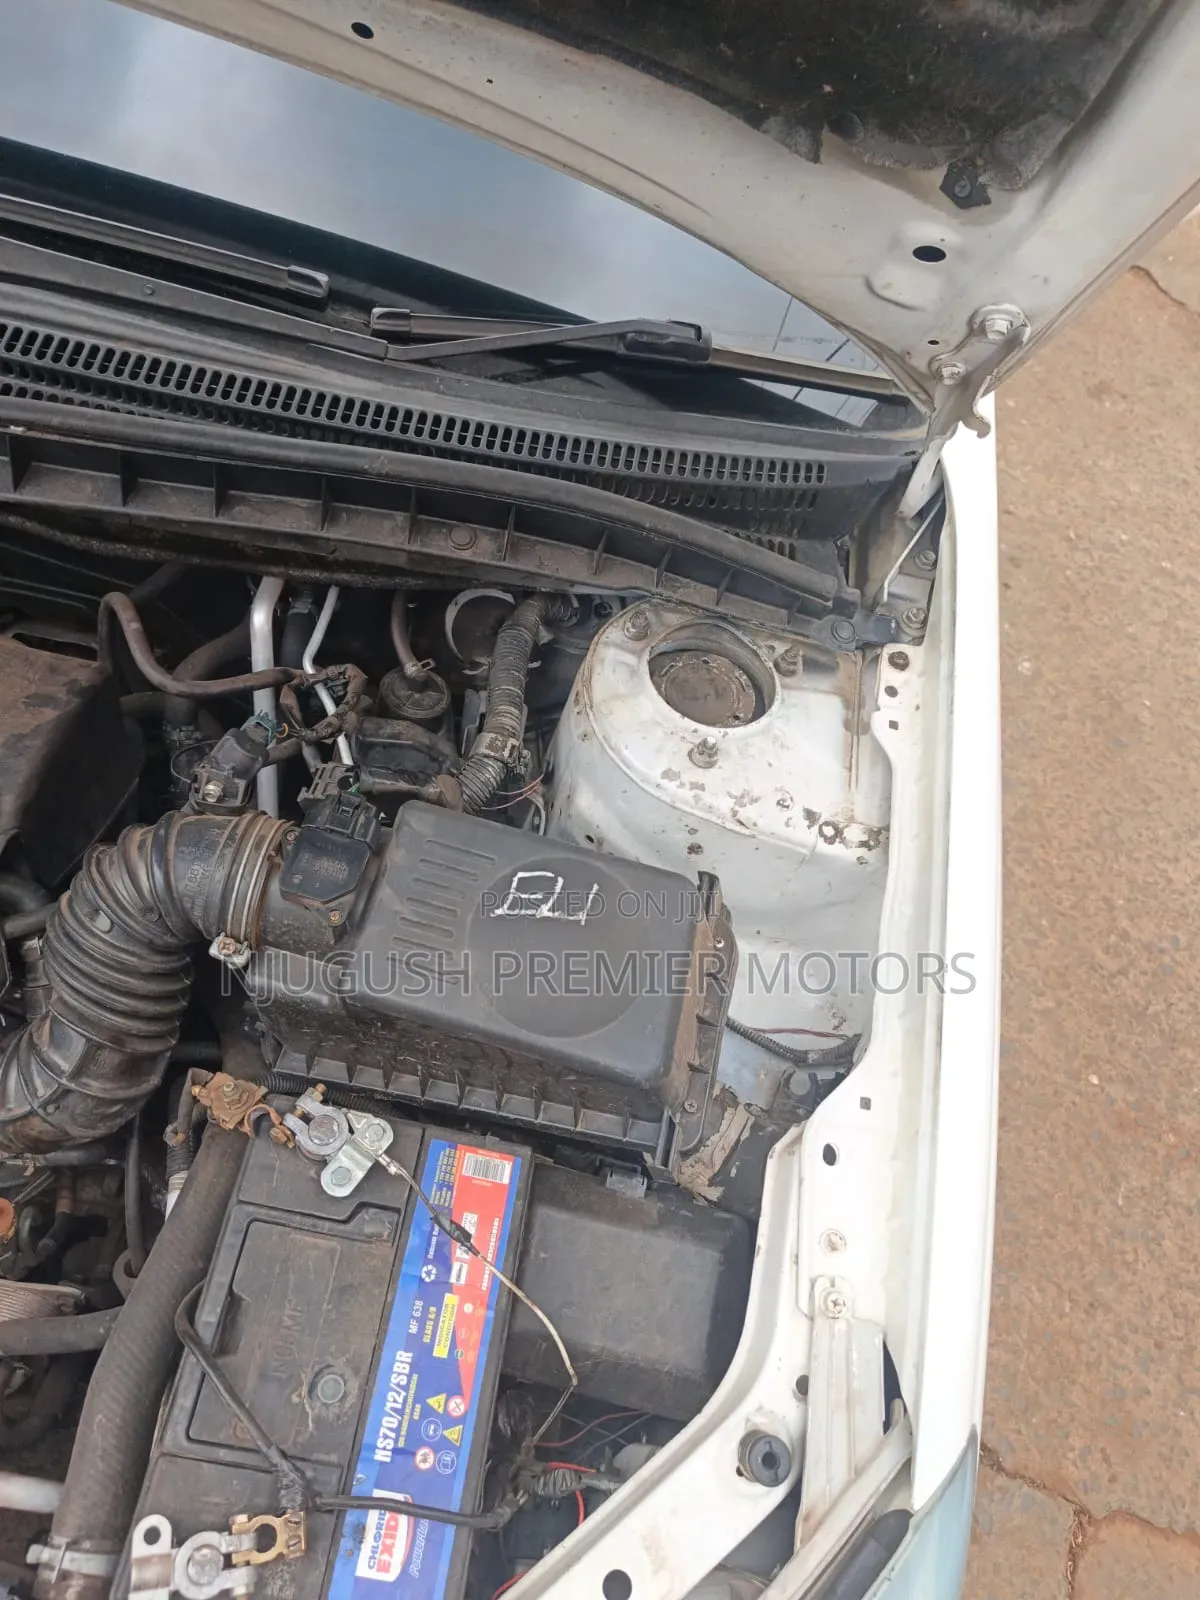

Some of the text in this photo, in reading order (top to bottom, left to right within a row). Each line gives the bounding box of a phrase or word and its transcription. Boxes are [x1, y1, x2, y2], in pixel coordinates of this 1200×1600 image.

[408, 1299, 424, 1334] MF 638
[373, 1349, 413, 1463] NS70/12/SBR
[367, 1508, 387, 1570] CHLORID
[375, 1509, 401, 1574] EXID
